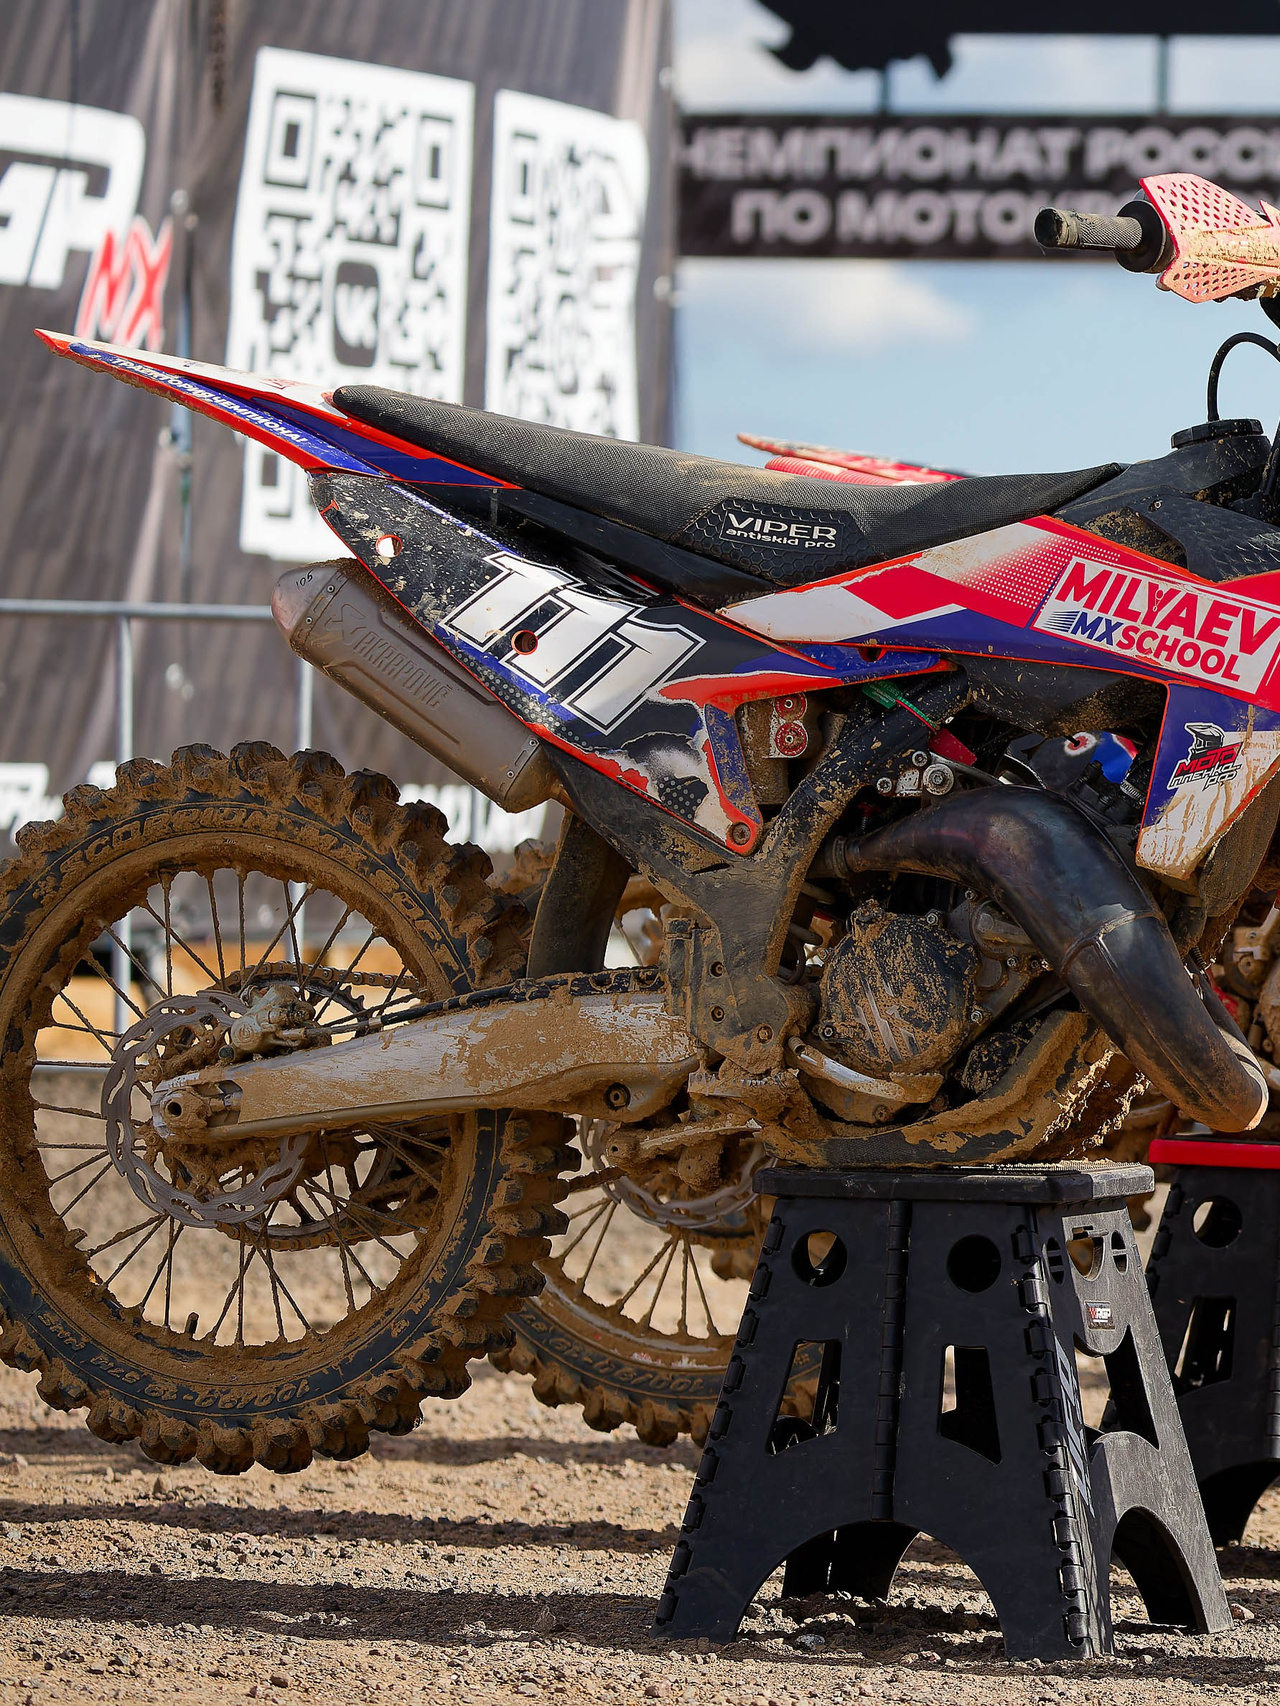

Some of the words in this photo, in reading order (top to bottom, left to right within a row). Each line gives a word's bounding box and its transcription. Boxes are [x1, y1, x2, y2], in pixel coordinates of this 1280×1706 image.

[683, 126, 1079, 181] ЧЕМПИОНАТ
[730, 188, 832, 245] ПО
[725, 528, 800, 546] antiskid
[804, 540, 836, 549] pro
[727, 513, 838, 541] VIPER
[438, 550, 708, 736] 111
